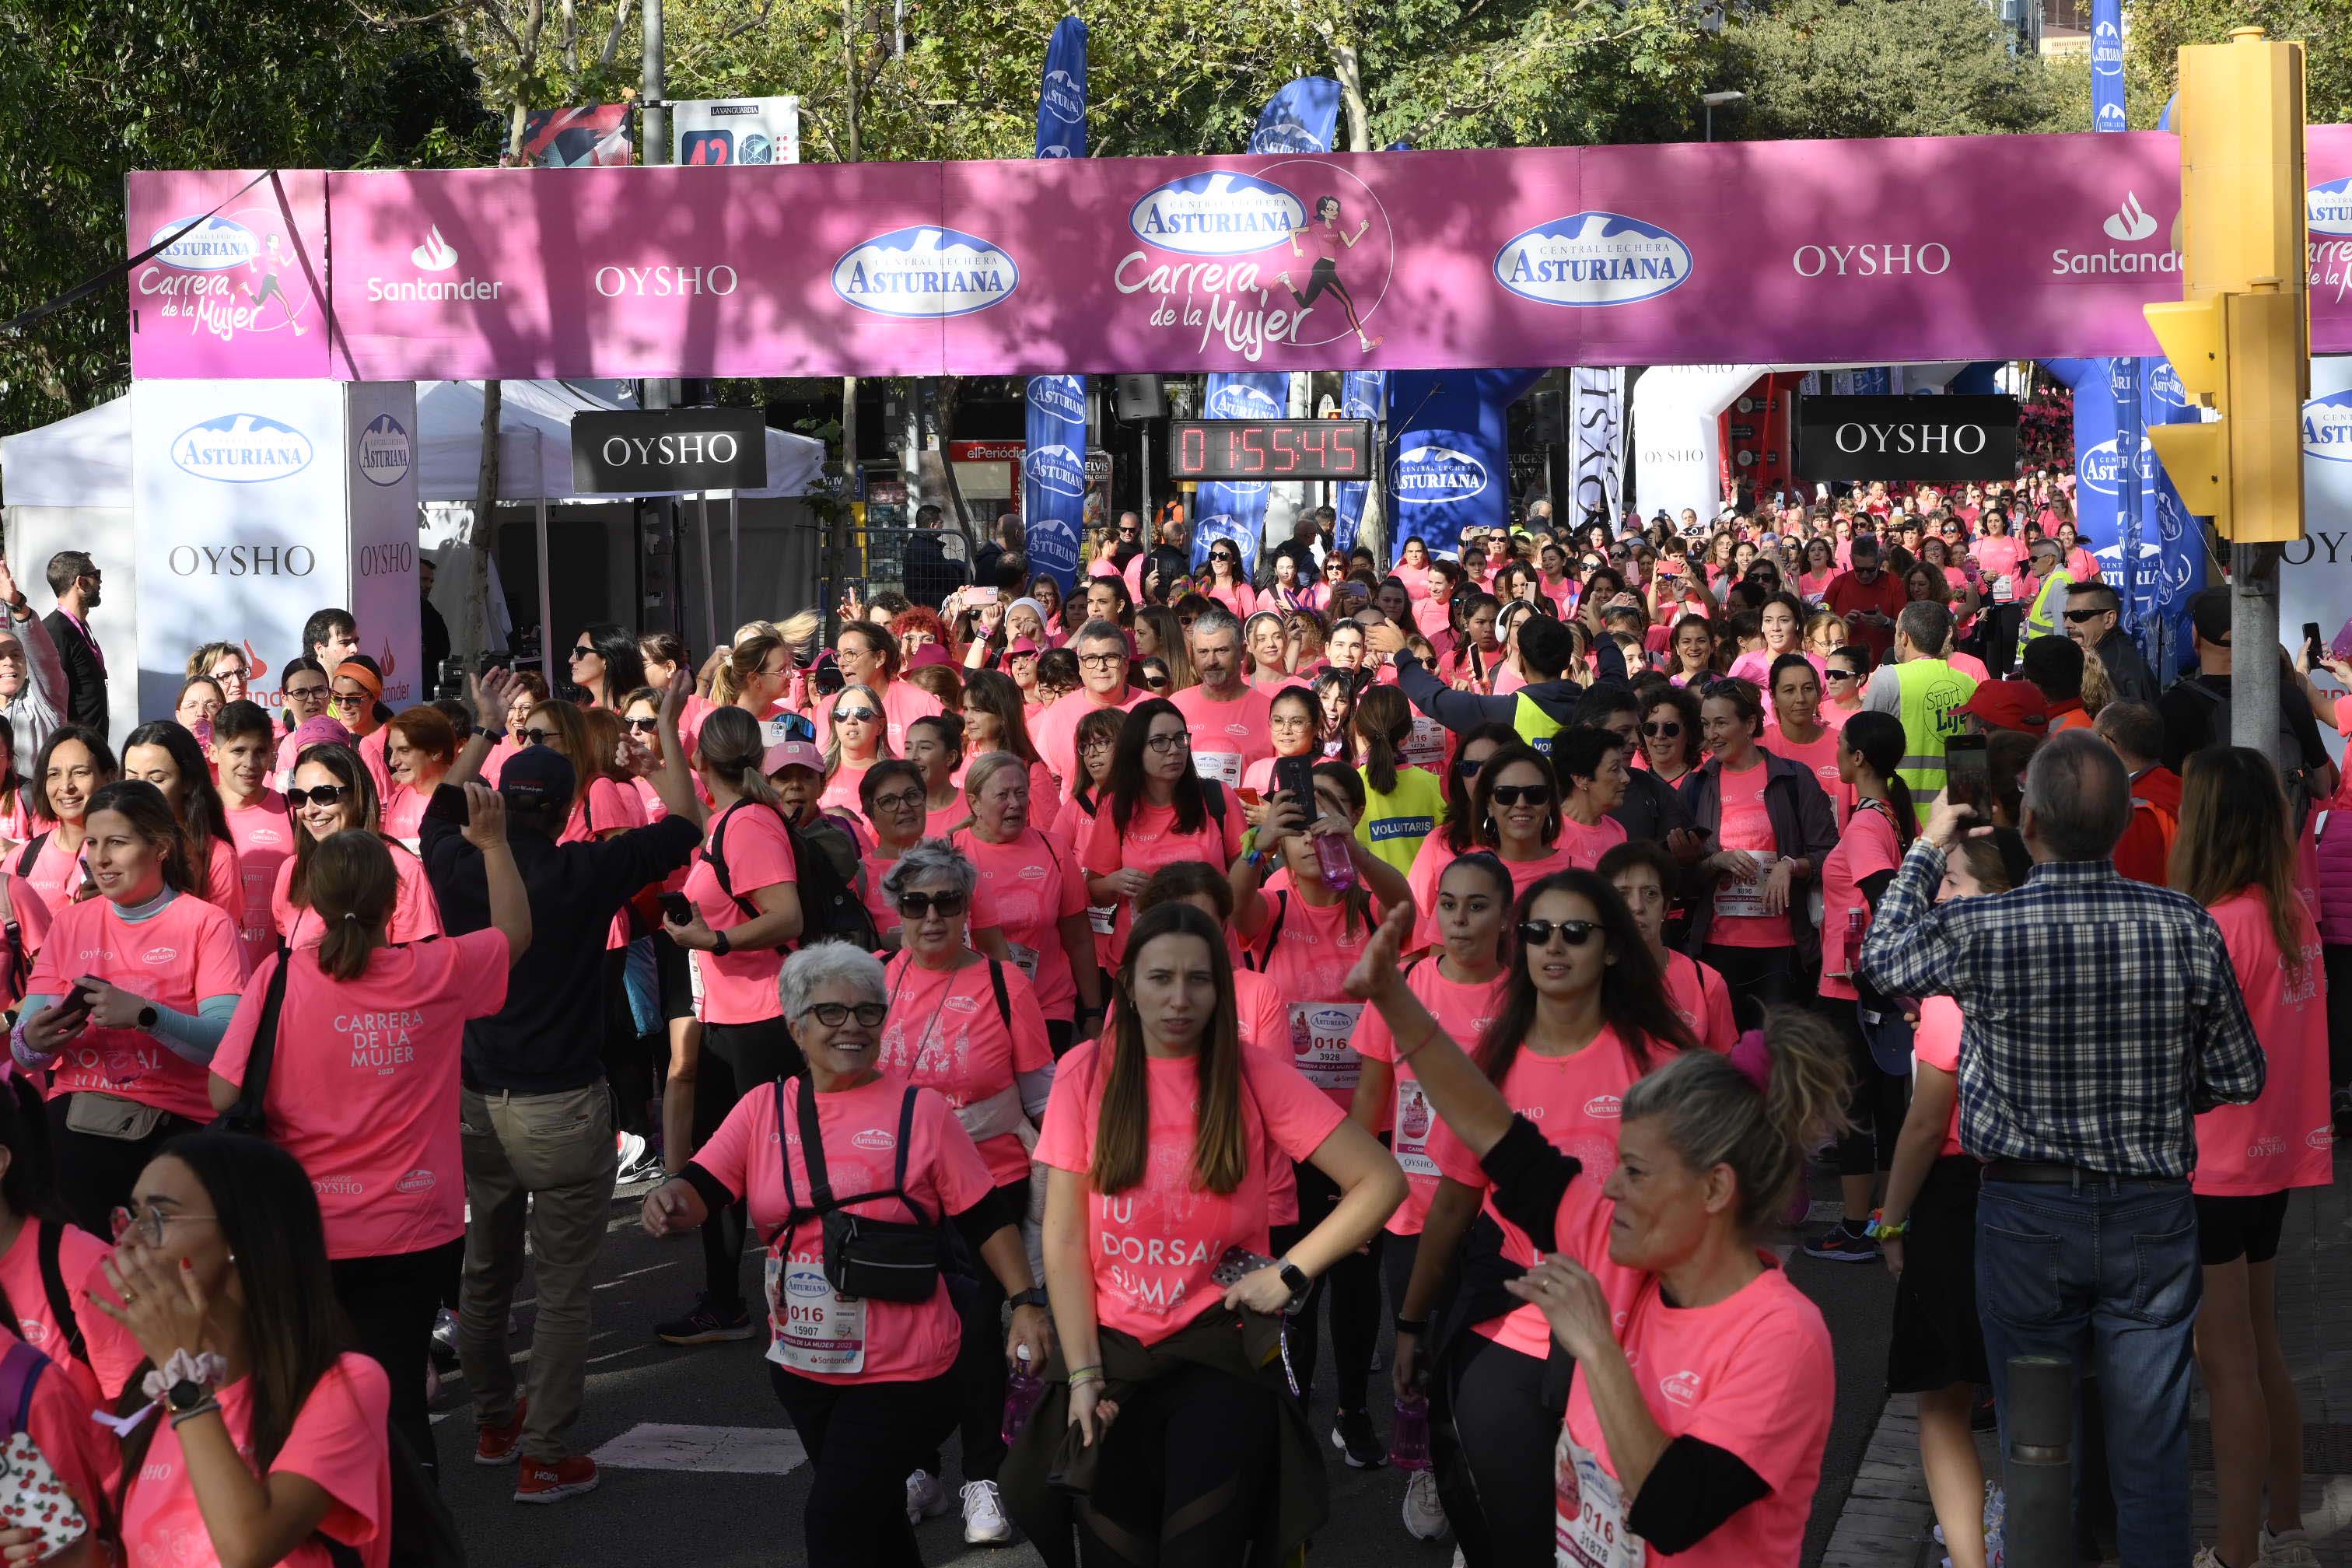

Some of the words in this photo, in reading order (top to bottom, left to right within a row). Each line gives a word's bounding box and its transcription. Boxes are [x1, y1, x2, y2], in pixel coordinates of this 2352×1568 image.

[1143, 203, 1293, 233] ASTURIANA
[939, 257, 997, 266] LECHERA
[1539, 244, 1601, 255] CENTRAL
[1607, 243, 1671, 253] LECHERA
[1793, 243, 1951, 278] OYSHO
[846, 261, 1004, 294] ASTURIANA
[1115, 251, 1260, 294] Carrera
[1509, 249, 1677, 282] ASTURIANA
[138, 267, 236, 296] Carrera
[367, 277, 502, 302] Santander
[596, 265, 737, 297] OYSHO
[161, 297, 178, 317] de
[181, 297, 195, 317] la
[191, 294, 265, 341] Mujer
[1150, 296, 1178, 326] de
[1183, 295, 1202, 326] la
[1198, 289, 1314, 362] Mujer
[1034, 382, 1084, 418] ASTURIANA
[184, 439, 303, 465] ASTURIANA
[603, 435, 738, 466] OYSHO
[1182, 429, 1355, 471] 01:55:45
[1836, 422, 1986, 454] OYSHO
[362, 441, 408, 468] ASTURIANA
[1085, 462, 1108, 471] ELVIS
[1644, 448, 1703, 464] OYSHO
[1031, 457, 1083, 490] ASTURIANA
[1392, 469, 1480, 490] ASTURIANA
[169, 545, 315, 576] OYSHO
[360, 541, 411, 577] OYSHO
[1927, 687, 1962, 710] Sport
[334, 1010, 425, 1033] CARRERA
[354, 1031, 380, 1049] DE
[387, 1029, 411, 1046] LA
[1314, 1037, 1347, 1050] 016
[351, 1046, 415, 1068] MUJER
[378, 1067, 394, 1076] 2023
[857, 1136, 893, 1146] ASTURIANA
[1404, 1158, 1433, 1168] OYSHO
[1101, 1194, 1132, 1223] TU
[788, 1280, 827, 1293] ASTURIANA
[1111, 1265, 1186, 1306] SUMA
[790, 1305, 824, 1322] 016
[794, 1325, 819, 1336] 15907
[1584, 1502, 1614, 1544] 016
